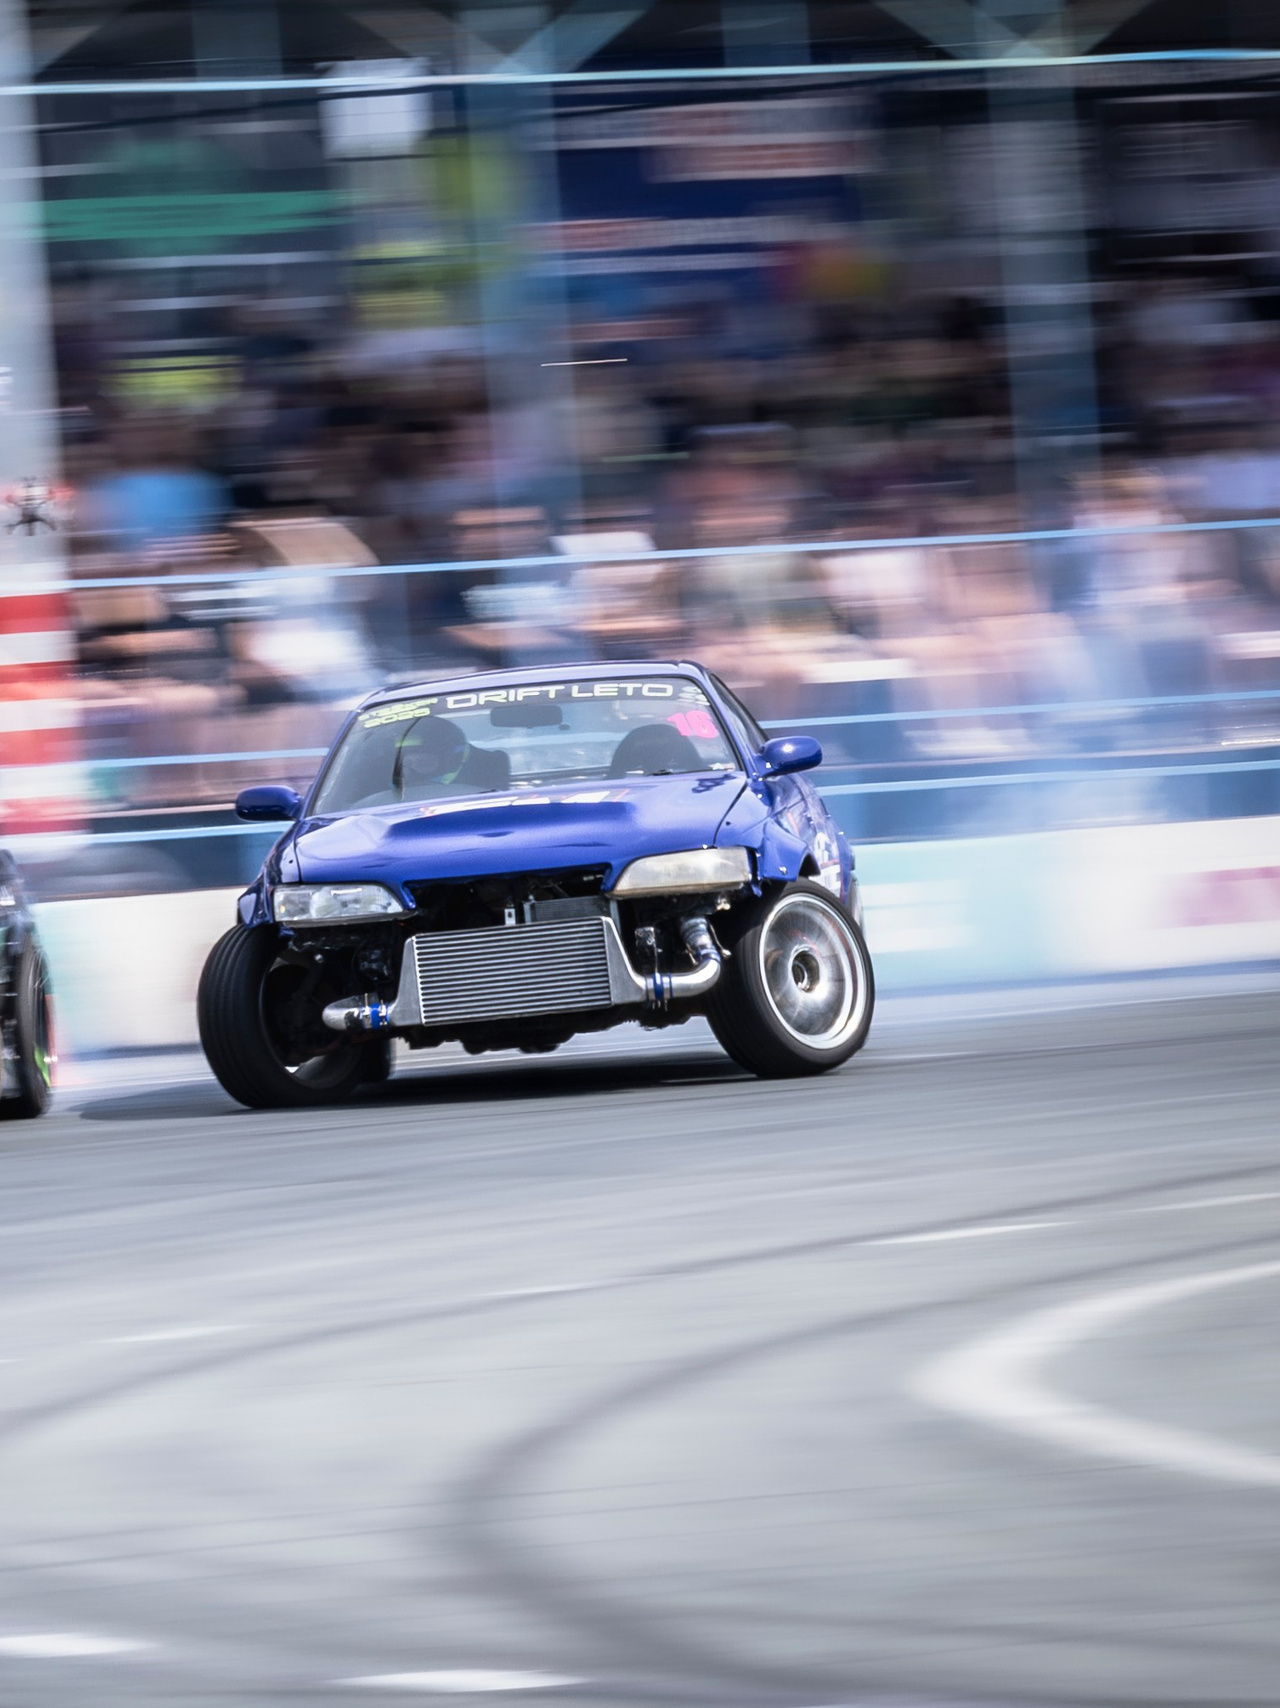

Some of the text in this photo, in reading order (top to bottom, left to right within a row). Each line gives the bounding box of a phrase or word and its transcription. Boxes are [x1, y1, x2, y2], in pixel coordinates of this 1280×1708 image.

[446, 685, 565, 709] DRIFT
[571, 683, 674, 698] LETO
[667, 710, 719, 739] 16
